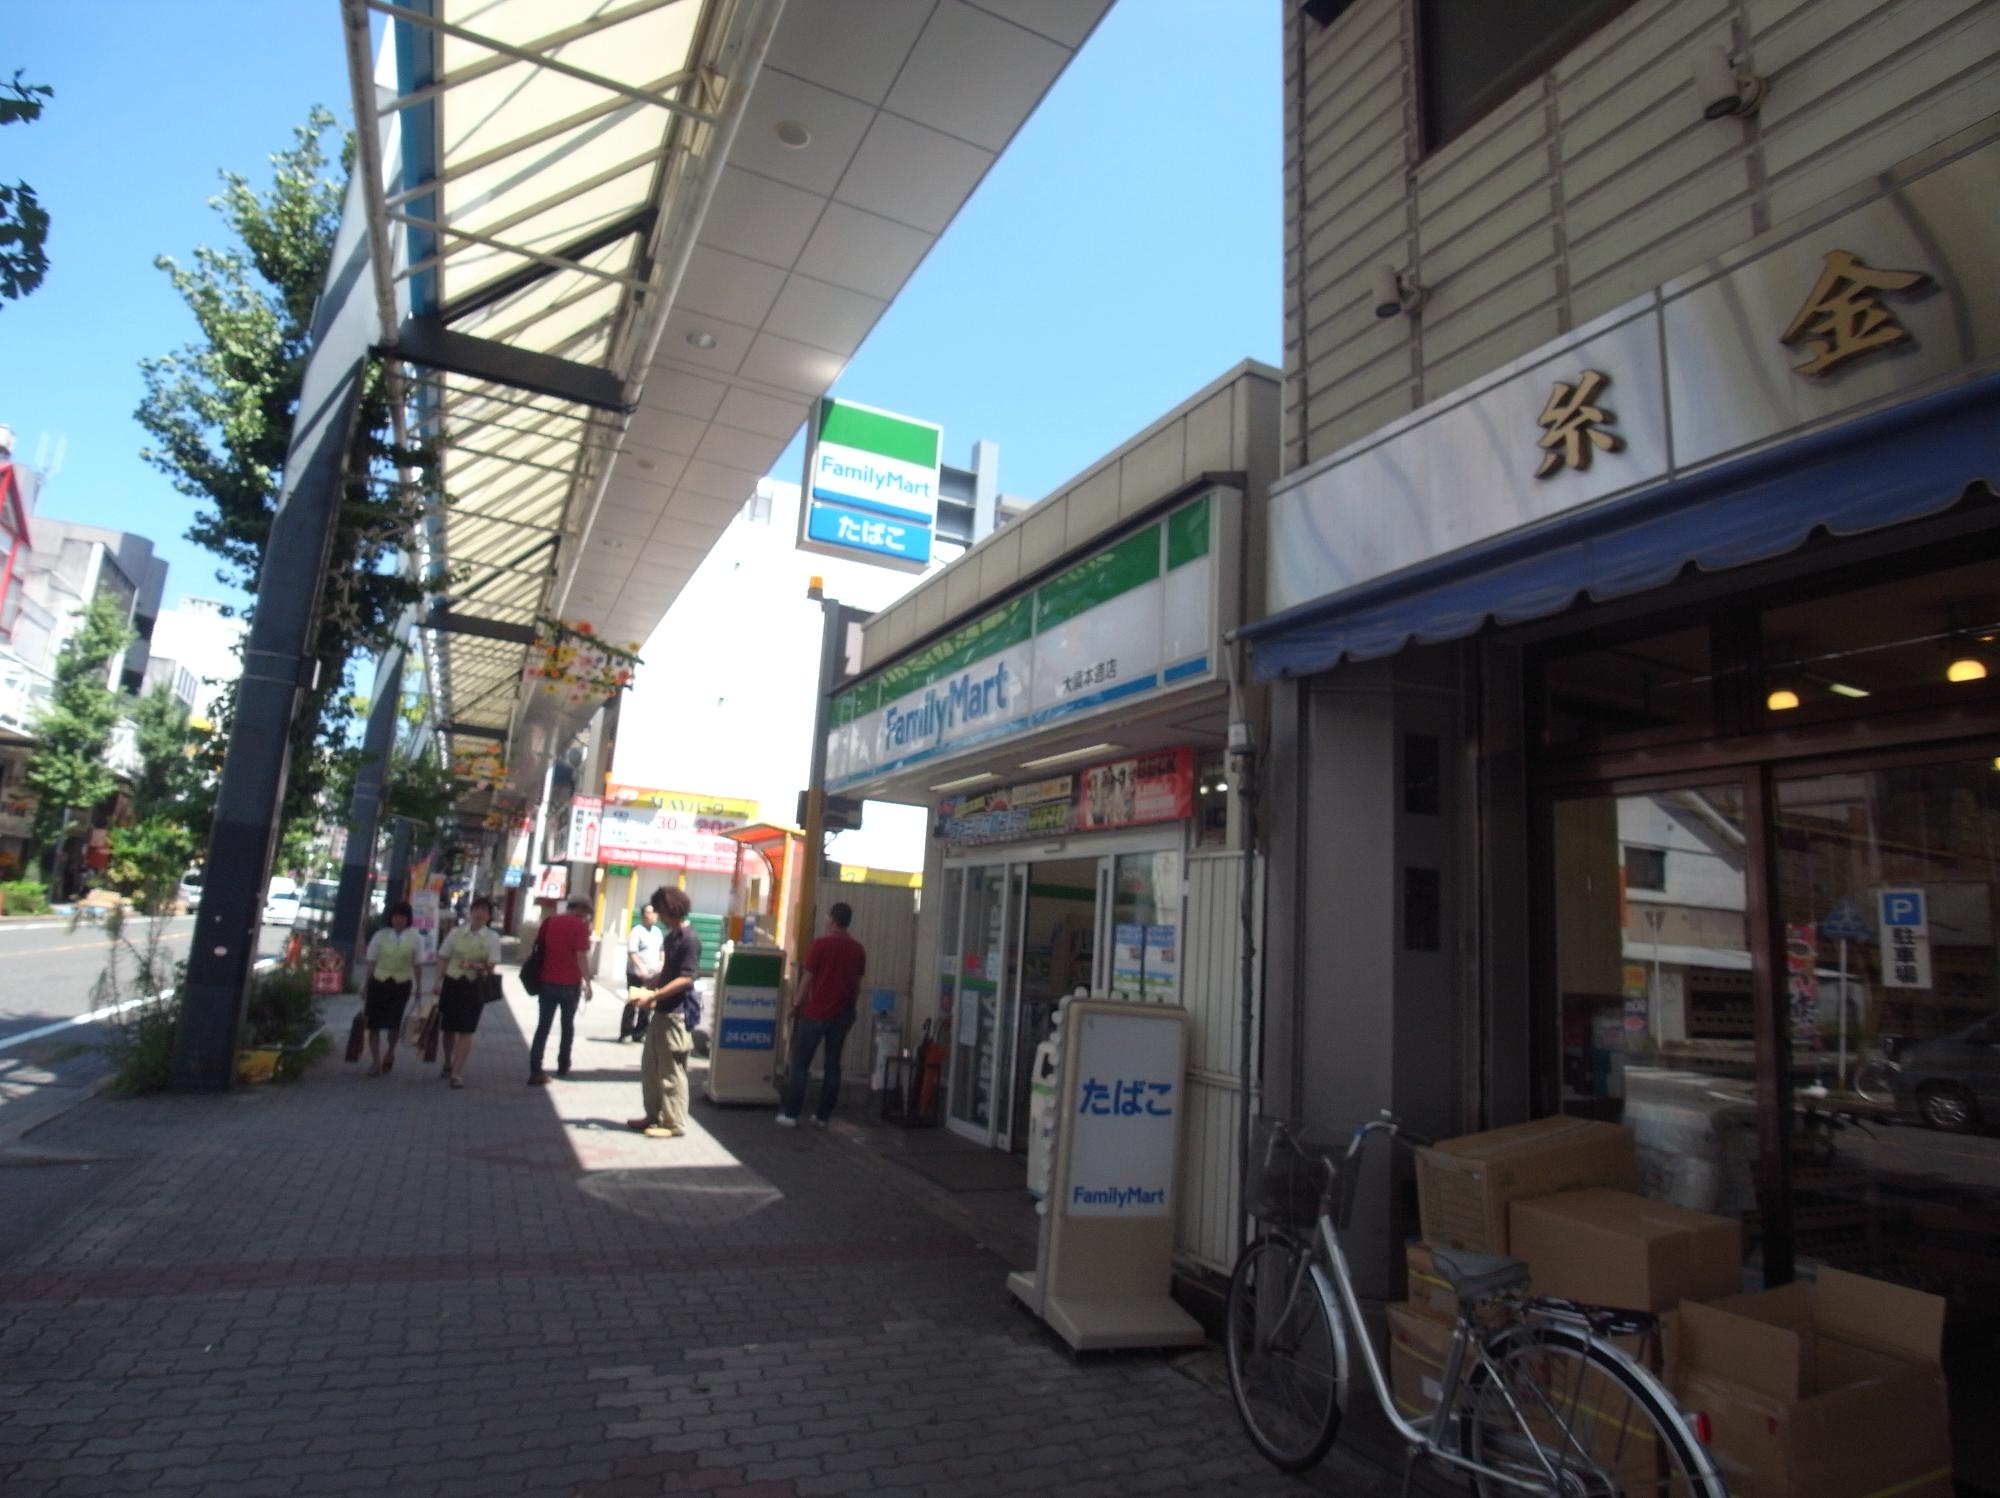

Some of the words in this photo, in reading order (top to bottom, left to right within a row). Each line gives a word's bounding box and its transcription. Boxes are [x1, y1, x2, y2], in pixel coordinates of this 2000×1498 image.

[821, 456, 931, 497] FamilyMart
[837, 515, 906, 551] たばこ
[886, 661, 1007, 750] FamilyMart
[1891, 899, 1913, 922] P
[1893, 927, 1919, 984] 駐車場
[740, 1031, 772, 1043] OPEN
[1079, 1078, 1172, 1116] たばこ
[1073, 1186, 1164, 1208] FamilyMart
